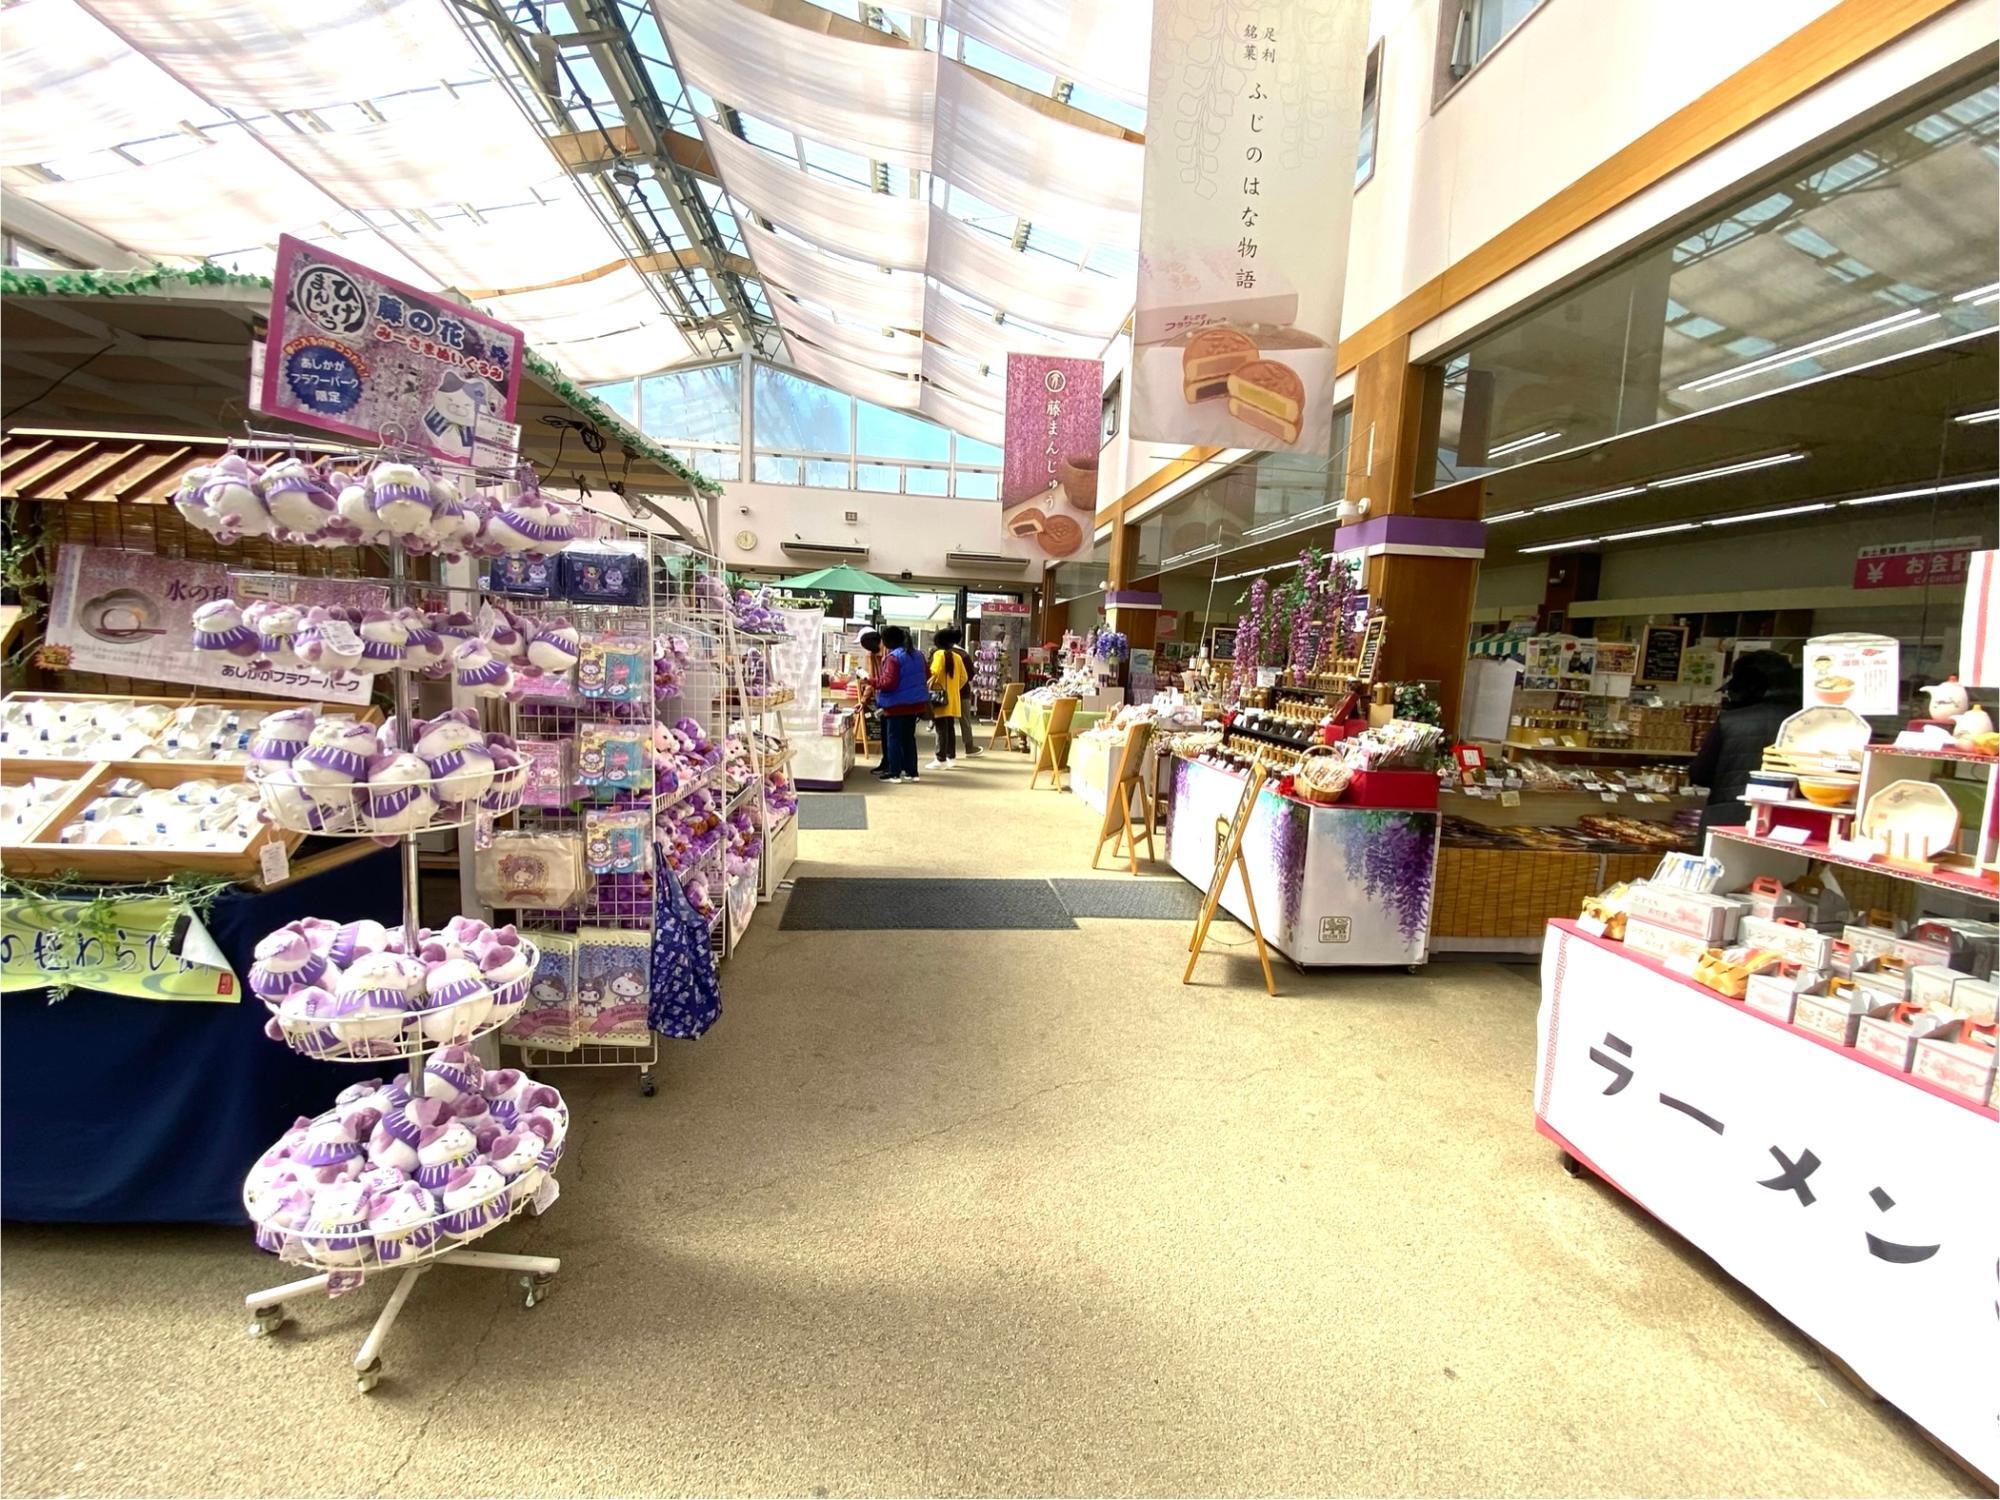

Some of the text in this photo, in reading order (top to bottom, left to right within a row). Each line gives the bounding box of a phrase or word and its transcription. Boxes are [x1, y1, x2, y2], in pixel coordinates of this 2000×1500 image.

[1244, 24, 1258, 61] 銘菓
[1262, 27, 1277, 63] 足利
[1236, 82, 1268, 289] ふじのはな物語
[305, 272, 338, 331] まんじゅう
[331, 280, 361, 325] ひげ
[376, 294, 464, 349] 藤の花
[300, 357, 346, 371] あしかが
[375, 324, 504, 380] みーさまぬいぐるみ
[290, 373, 359, 389] フラワーパーク
[315, 389, 341, 403] 限定
[1045, 400, 1062, 509] 藤まんじゅう
[1905, 553, 1969, 576] お会計
[998, 604, 1026, 612] トイレ
[220, 663, 360, 693] あしかがフラワーパーク
[1589, 1032, 1941, 1264] ラーメン
